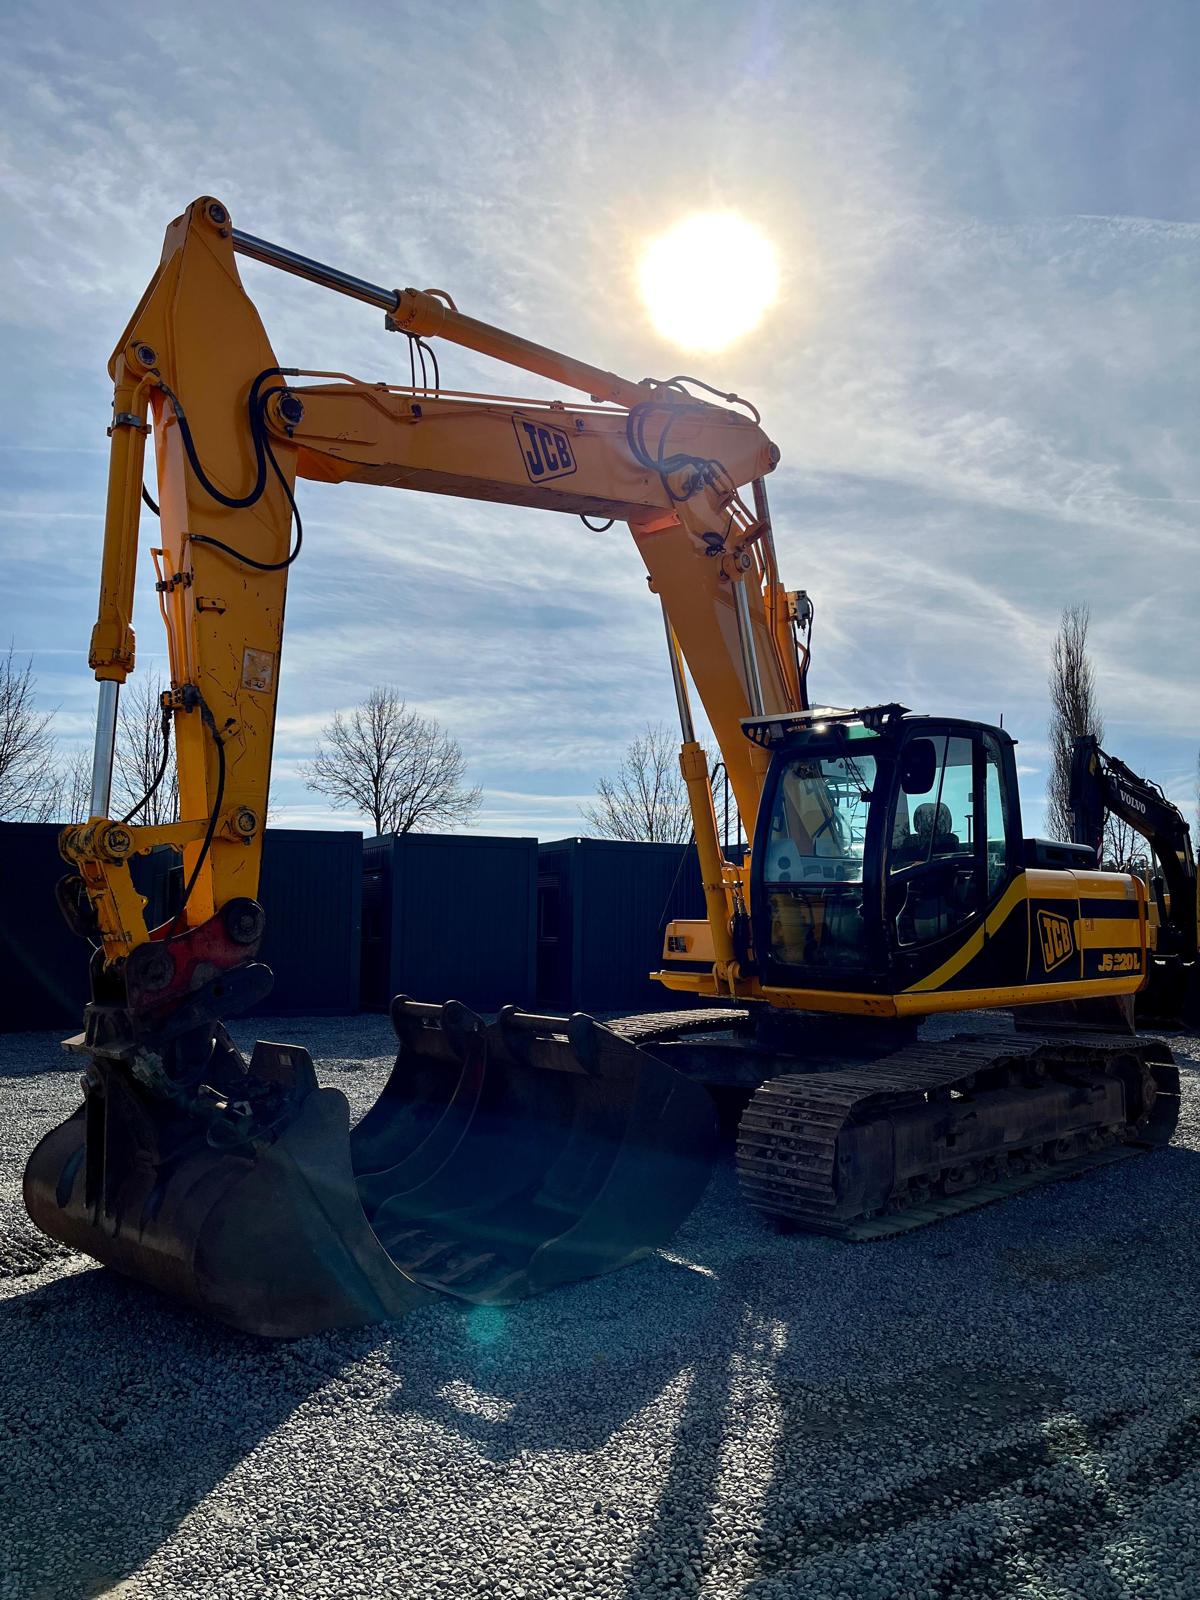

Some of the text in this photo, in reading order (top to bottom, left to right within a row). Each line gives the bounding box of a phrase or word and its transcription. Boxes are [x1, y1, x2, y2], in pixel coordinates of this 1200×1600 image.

[522, 421, 572, 475] JCB
[1120, 789, 1146, 814] VOLVO
[1043, 916, 1070, 965] JCB
